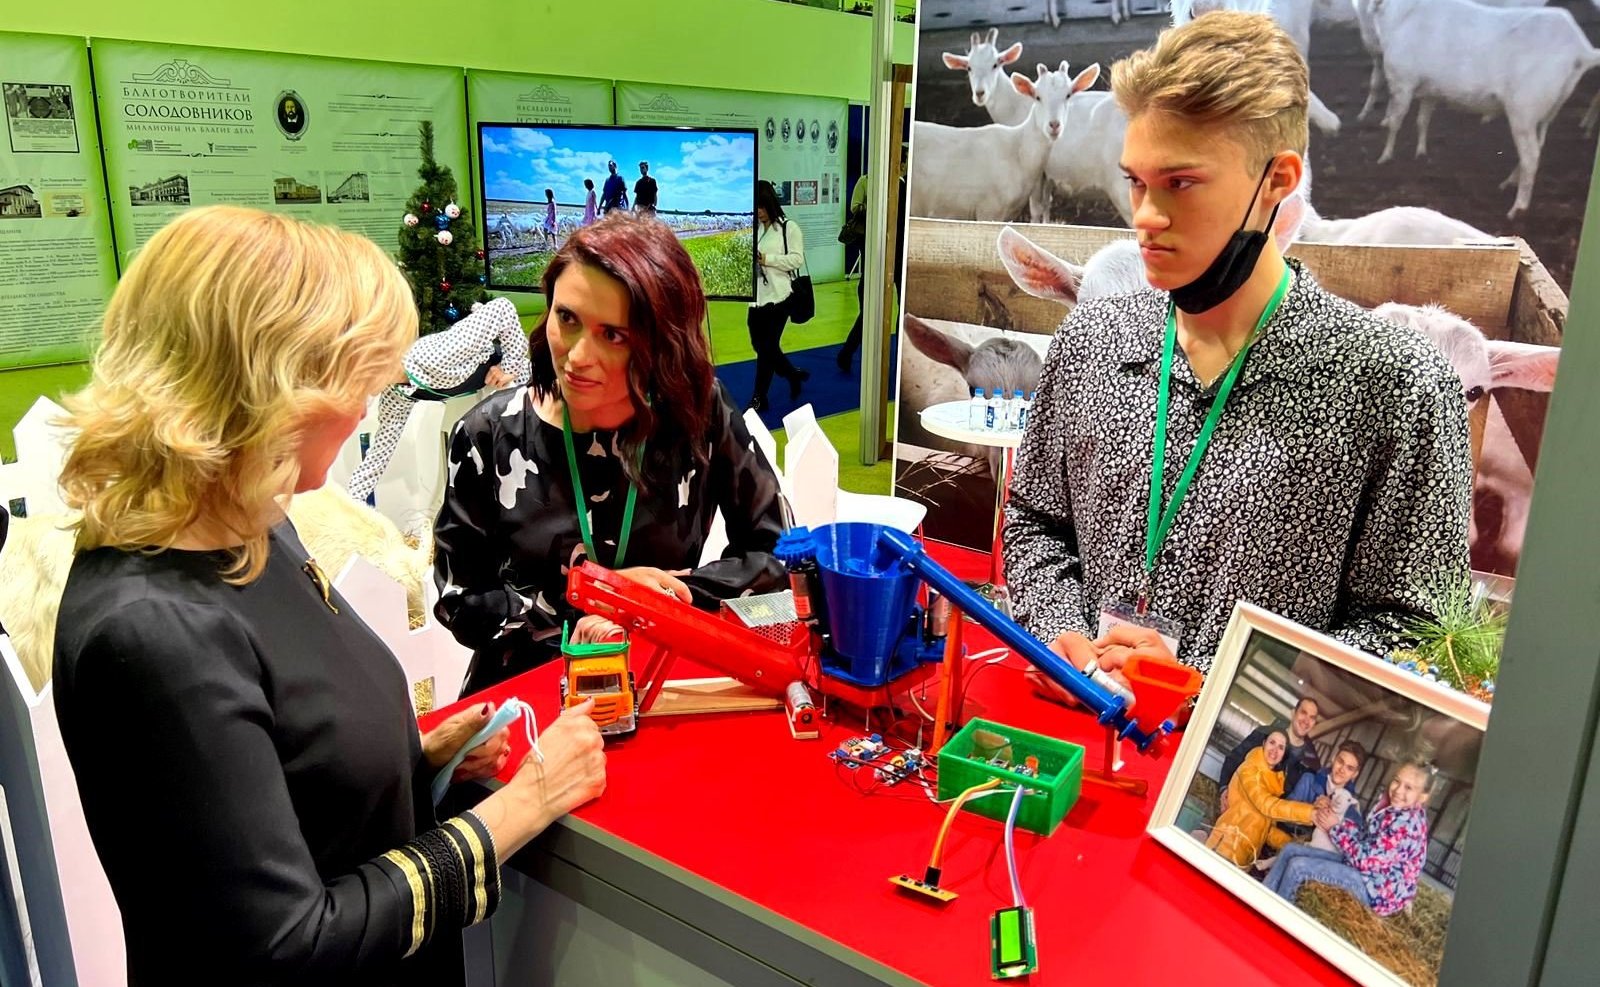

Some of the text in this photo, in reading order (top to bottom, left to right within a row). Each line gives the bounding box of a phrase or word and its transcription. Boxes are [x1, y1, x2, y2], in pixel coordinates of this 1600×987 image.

[123, 87, 251, 102] БЛАГОТВОРИТЕЛИ
[124, 104, 253, 121] СОЛОДОВНИКОВ
[126, 124, 181, 132] МИЛЛИОНЫ
[233, 127, 255, 135] ДЕЛА
